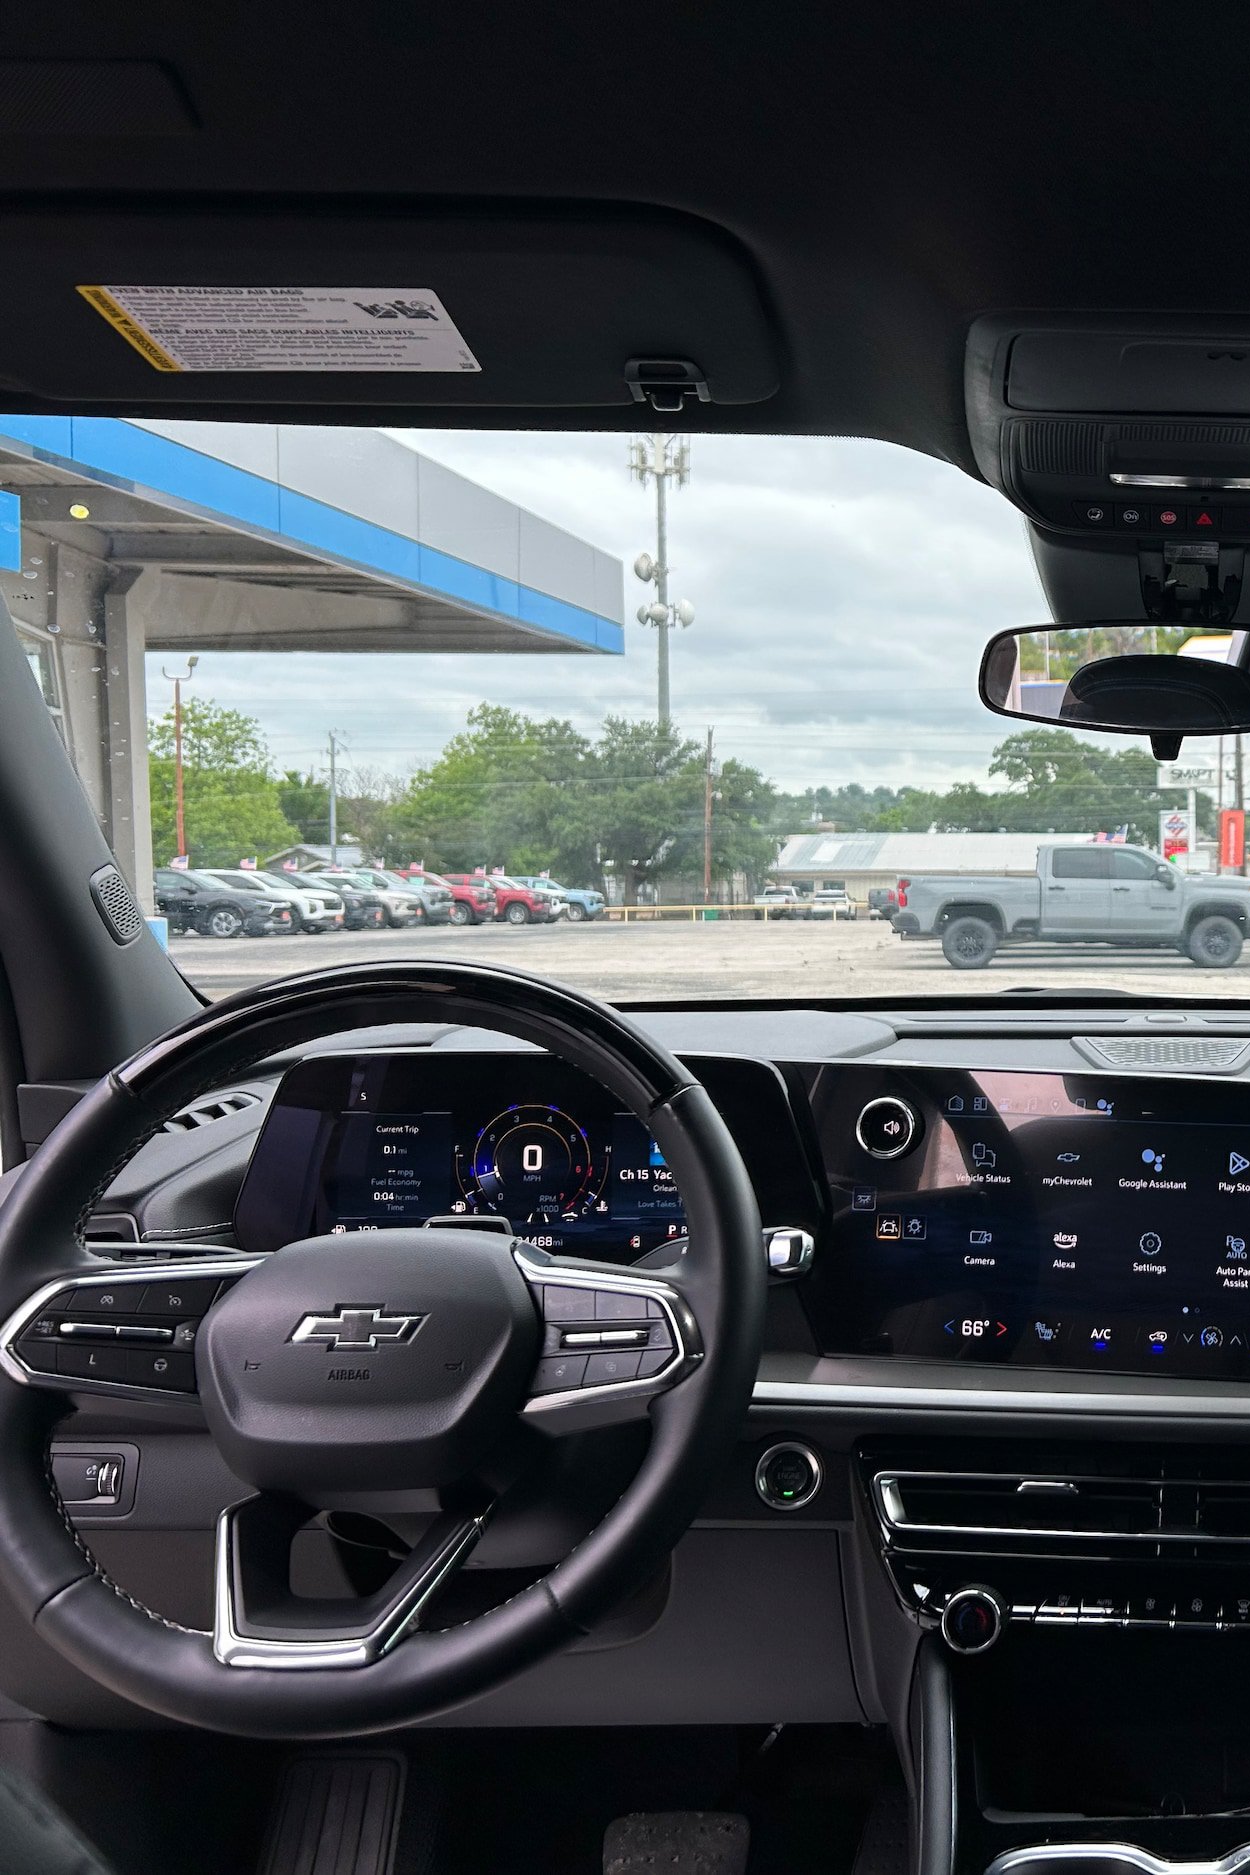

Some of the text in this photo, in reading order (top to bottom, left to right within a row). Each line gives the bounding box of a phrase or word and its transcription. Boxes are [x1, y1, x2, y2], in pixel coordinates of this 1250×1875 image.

[361, 1092, 367, 1100] S
[376, 1125, 419, 1134] Current Trip
[383, 1145, 396, 1154] 0.1
[523, 1145, 543, 1171] 0
[620, 1169, 672, 1180] Ch 15 Yac
[955, 1173, 1011, 1183] Vehicle Status
[388, 1178, 421, 1187] Economy
[1042, 1176, 1092, 1187] myChevrolet
[1118, 1178, 1187, 1189] Google Assistant
[653, 1184, 678, 1192] Orlean
[1218, 1182, 1235, 1193] Play
[373, 1191, 394, 1201] 0:04
[386, 1203, 404, 1211] Time
[638, 1200, 654, 1208] Love
[656, 1200, 676, 1208] Takes
[668, 1225, 688, 1235] P R
[1053, 1232, 1078, 1242] alexa
[1226, 1251, 1247, 1259] AUTO
[964, 1255, 995, 1266] Camera
[1052, 1259, 1076, 1269] Alexa
[1132, 1262, 1167, 1275] Settings
[1216, 1266, 1236, 1276] Auto
[1223, 1278, 1248, 1288] Assist
[1090, 1328, 1112, 1339] A/C
[327, 1369, 370, 1381] AIRBAG
